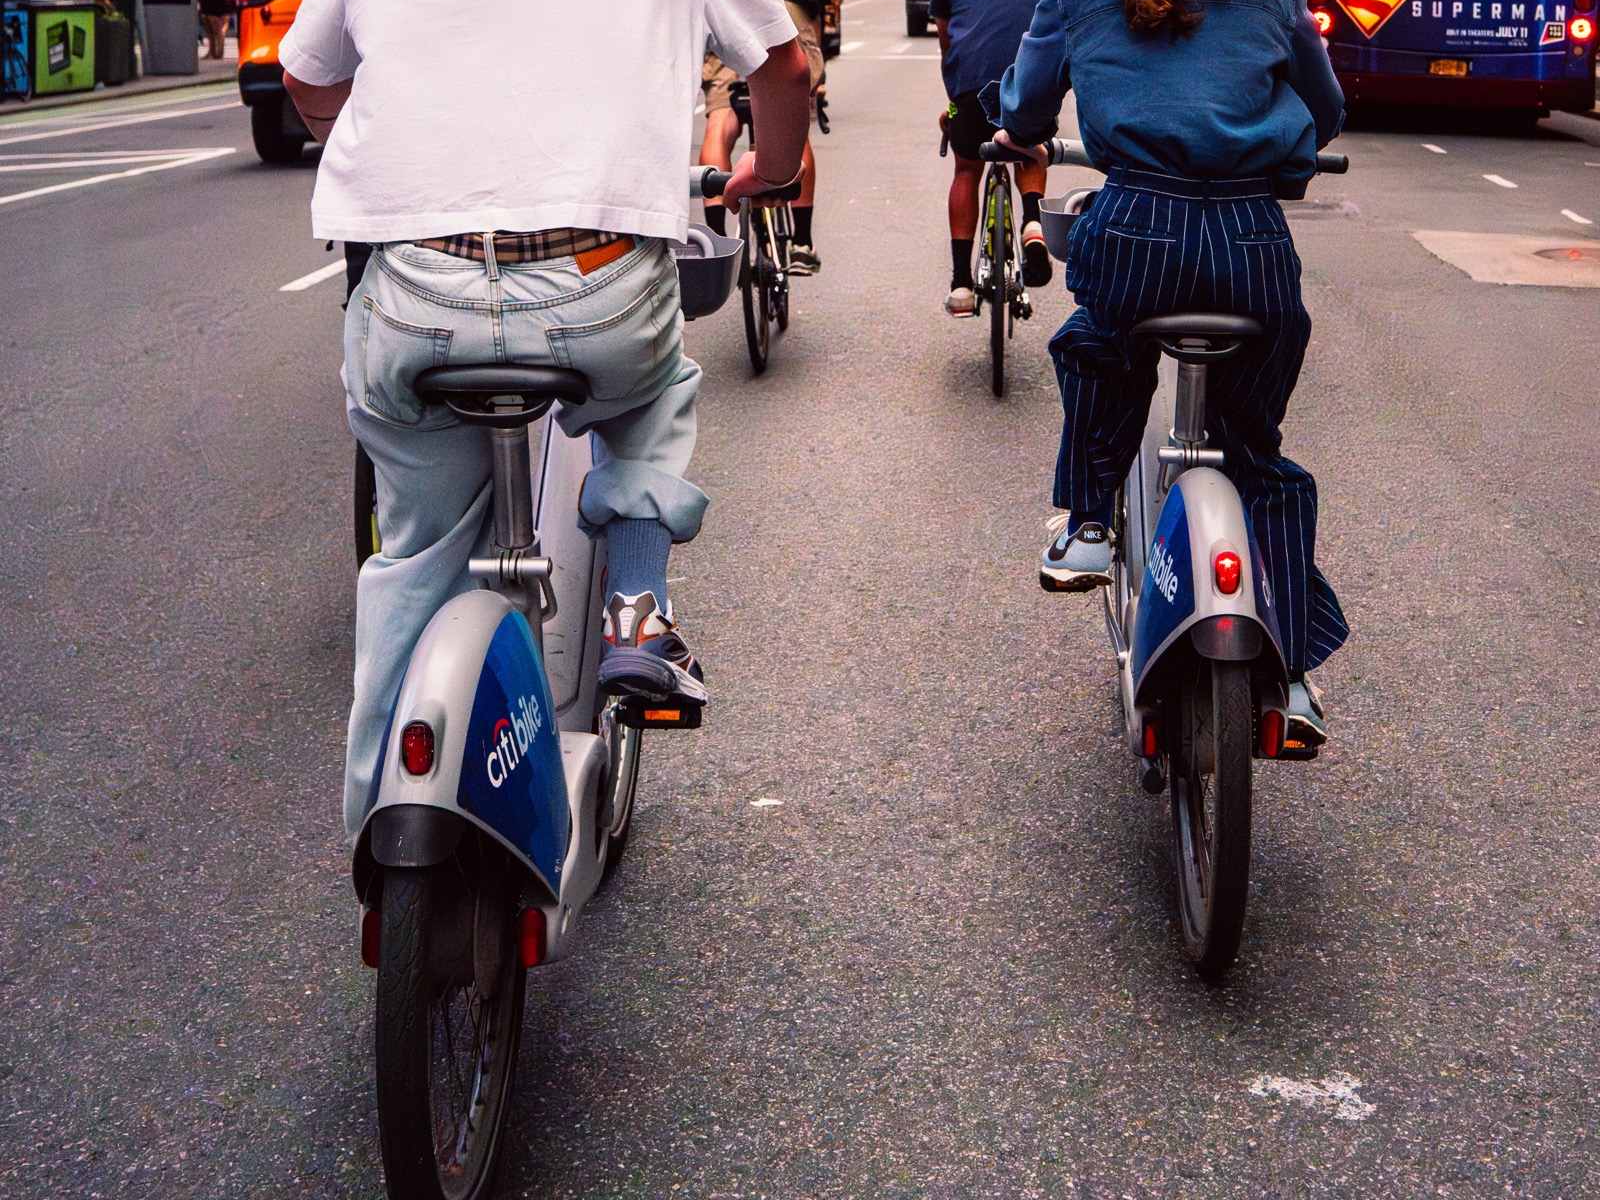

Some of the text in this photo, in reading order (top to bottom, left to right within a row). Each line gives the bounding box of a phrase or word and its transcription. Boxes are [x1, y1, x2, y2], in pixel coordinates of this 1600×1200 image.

[1412, 0, 1566, 22] SUPERMAN
[1495, 26, 1518, 38] JULY
[1520, 27, 1528, 38] 11
[1084, 530, 1102, 540] NIKE
